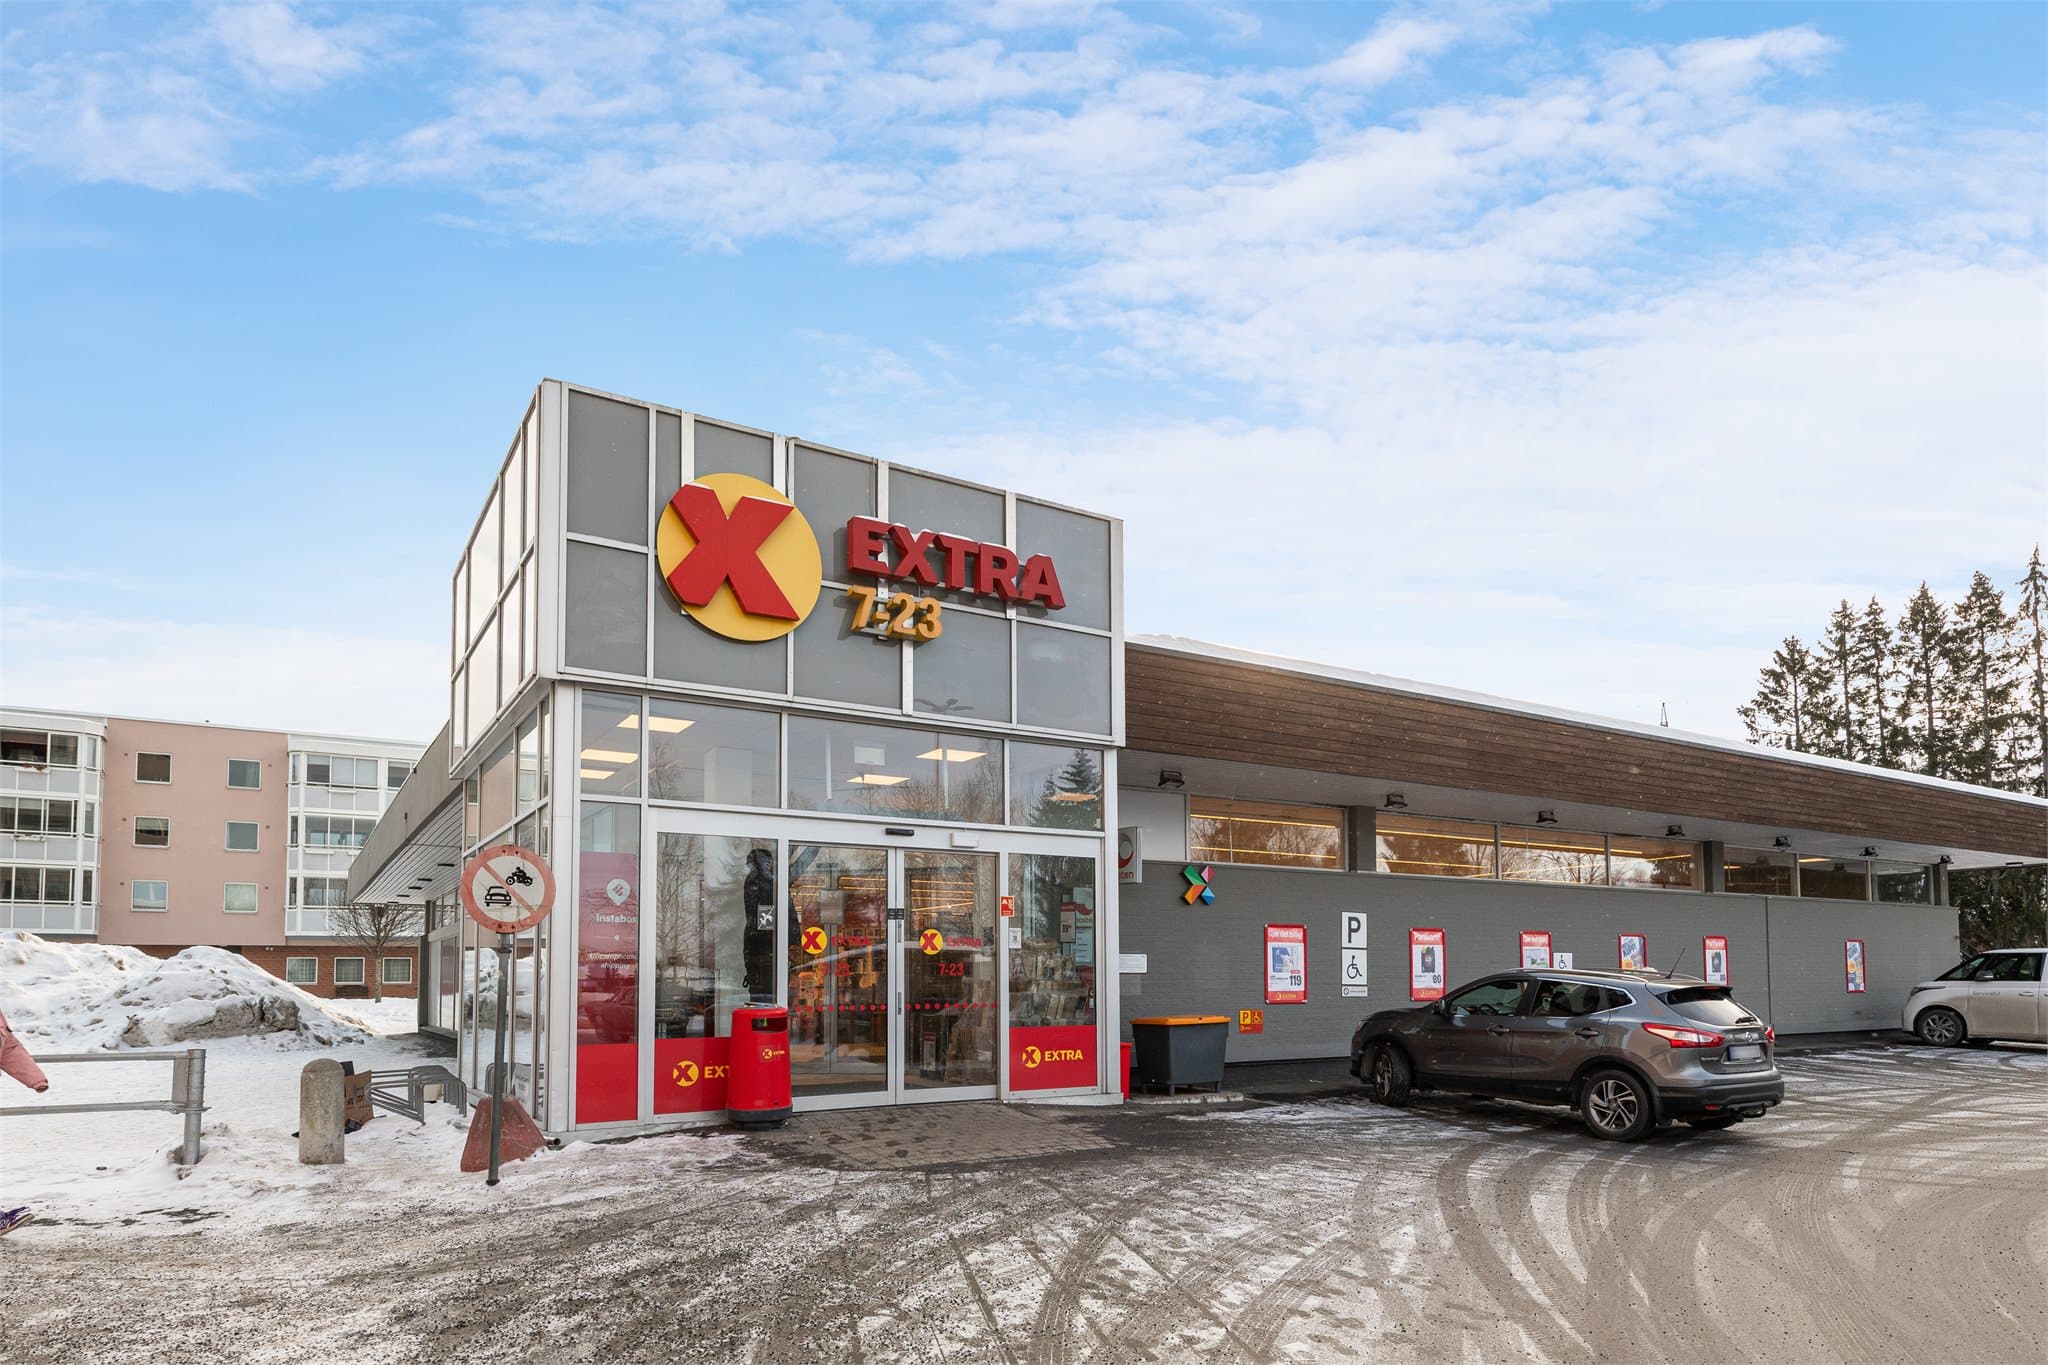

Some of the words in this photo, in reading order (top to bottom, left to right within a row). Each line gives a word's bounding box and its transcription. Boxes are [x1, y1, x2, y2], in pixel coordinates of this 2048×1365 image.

[847, 515, 1066, 610] EXTRA
[848, 585, 943, 643] 7-23
[1347, 916, 1361, 943] P
[946, 936, 982, 948] EXTRA
[938, 962, 964, 977] 7-23
[1290, 975, 1302, 986] 119
[1243, 1012, 1249, 1023] P
[1044, 1049, 1084, 1062] EXTRA
